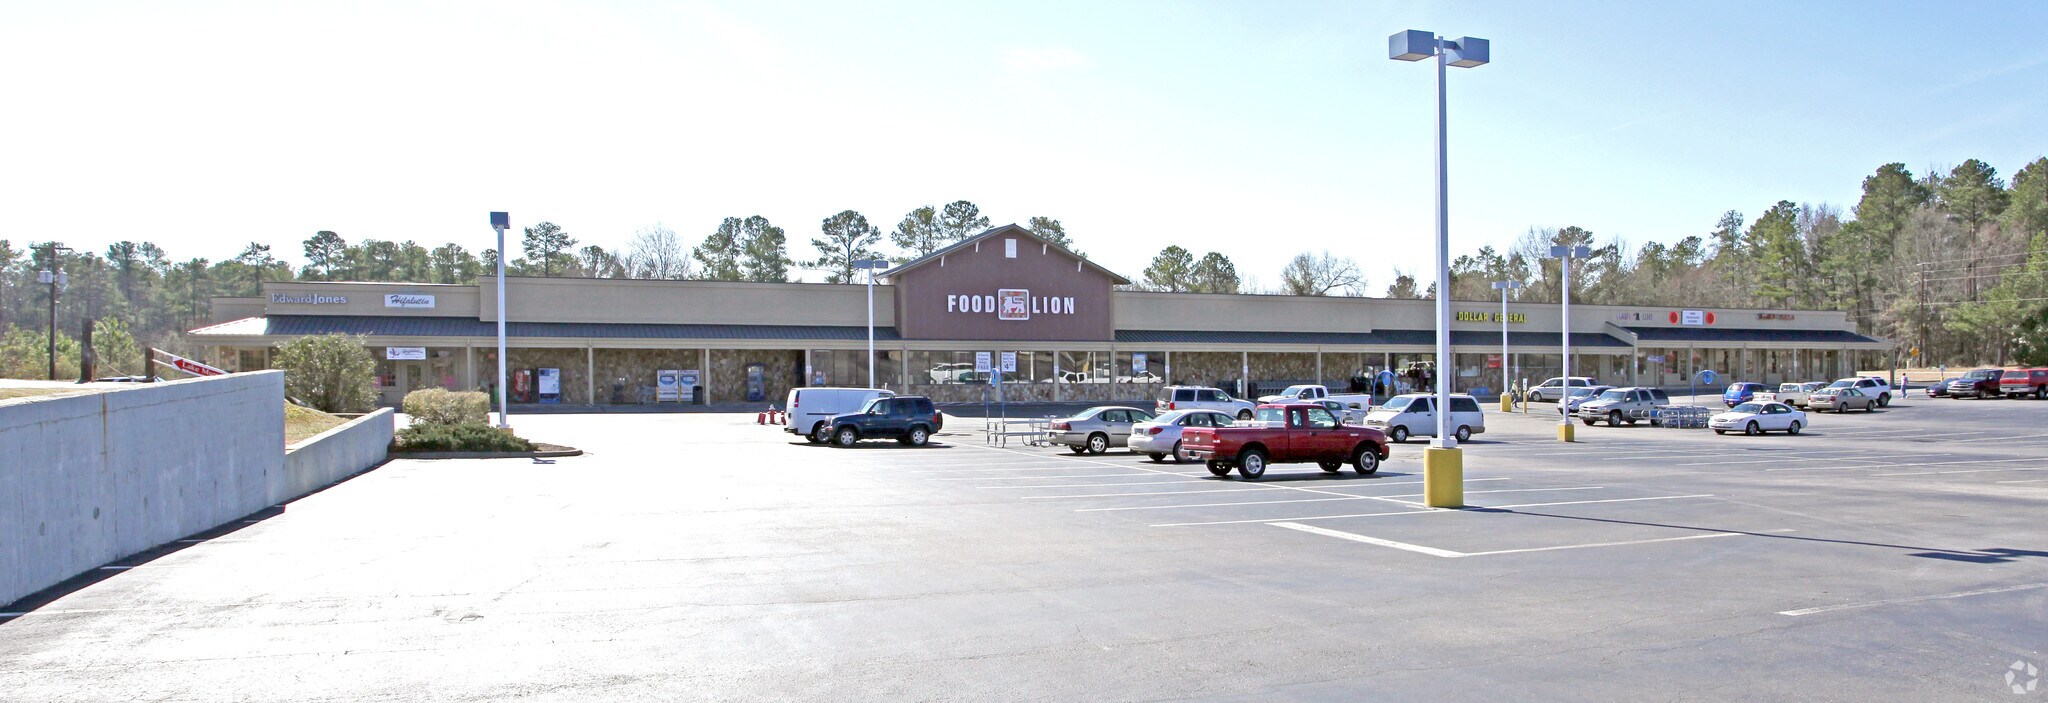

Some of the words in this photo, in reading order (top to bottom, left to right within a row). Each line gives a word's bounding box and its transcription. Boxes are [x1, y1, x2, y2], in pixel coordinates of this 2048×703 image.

[271, 293, 313, 304] Edward
[313, 294, 347, 305] Jones
[947, 294, 996, 313] FOOD
[1032, 296, 1075, 315] LION
[1457, 311, 1489, 322] DOLLAR
[1494, 312, 1528, 323] GEERAL
[182, 361, 200, 373] Lake
